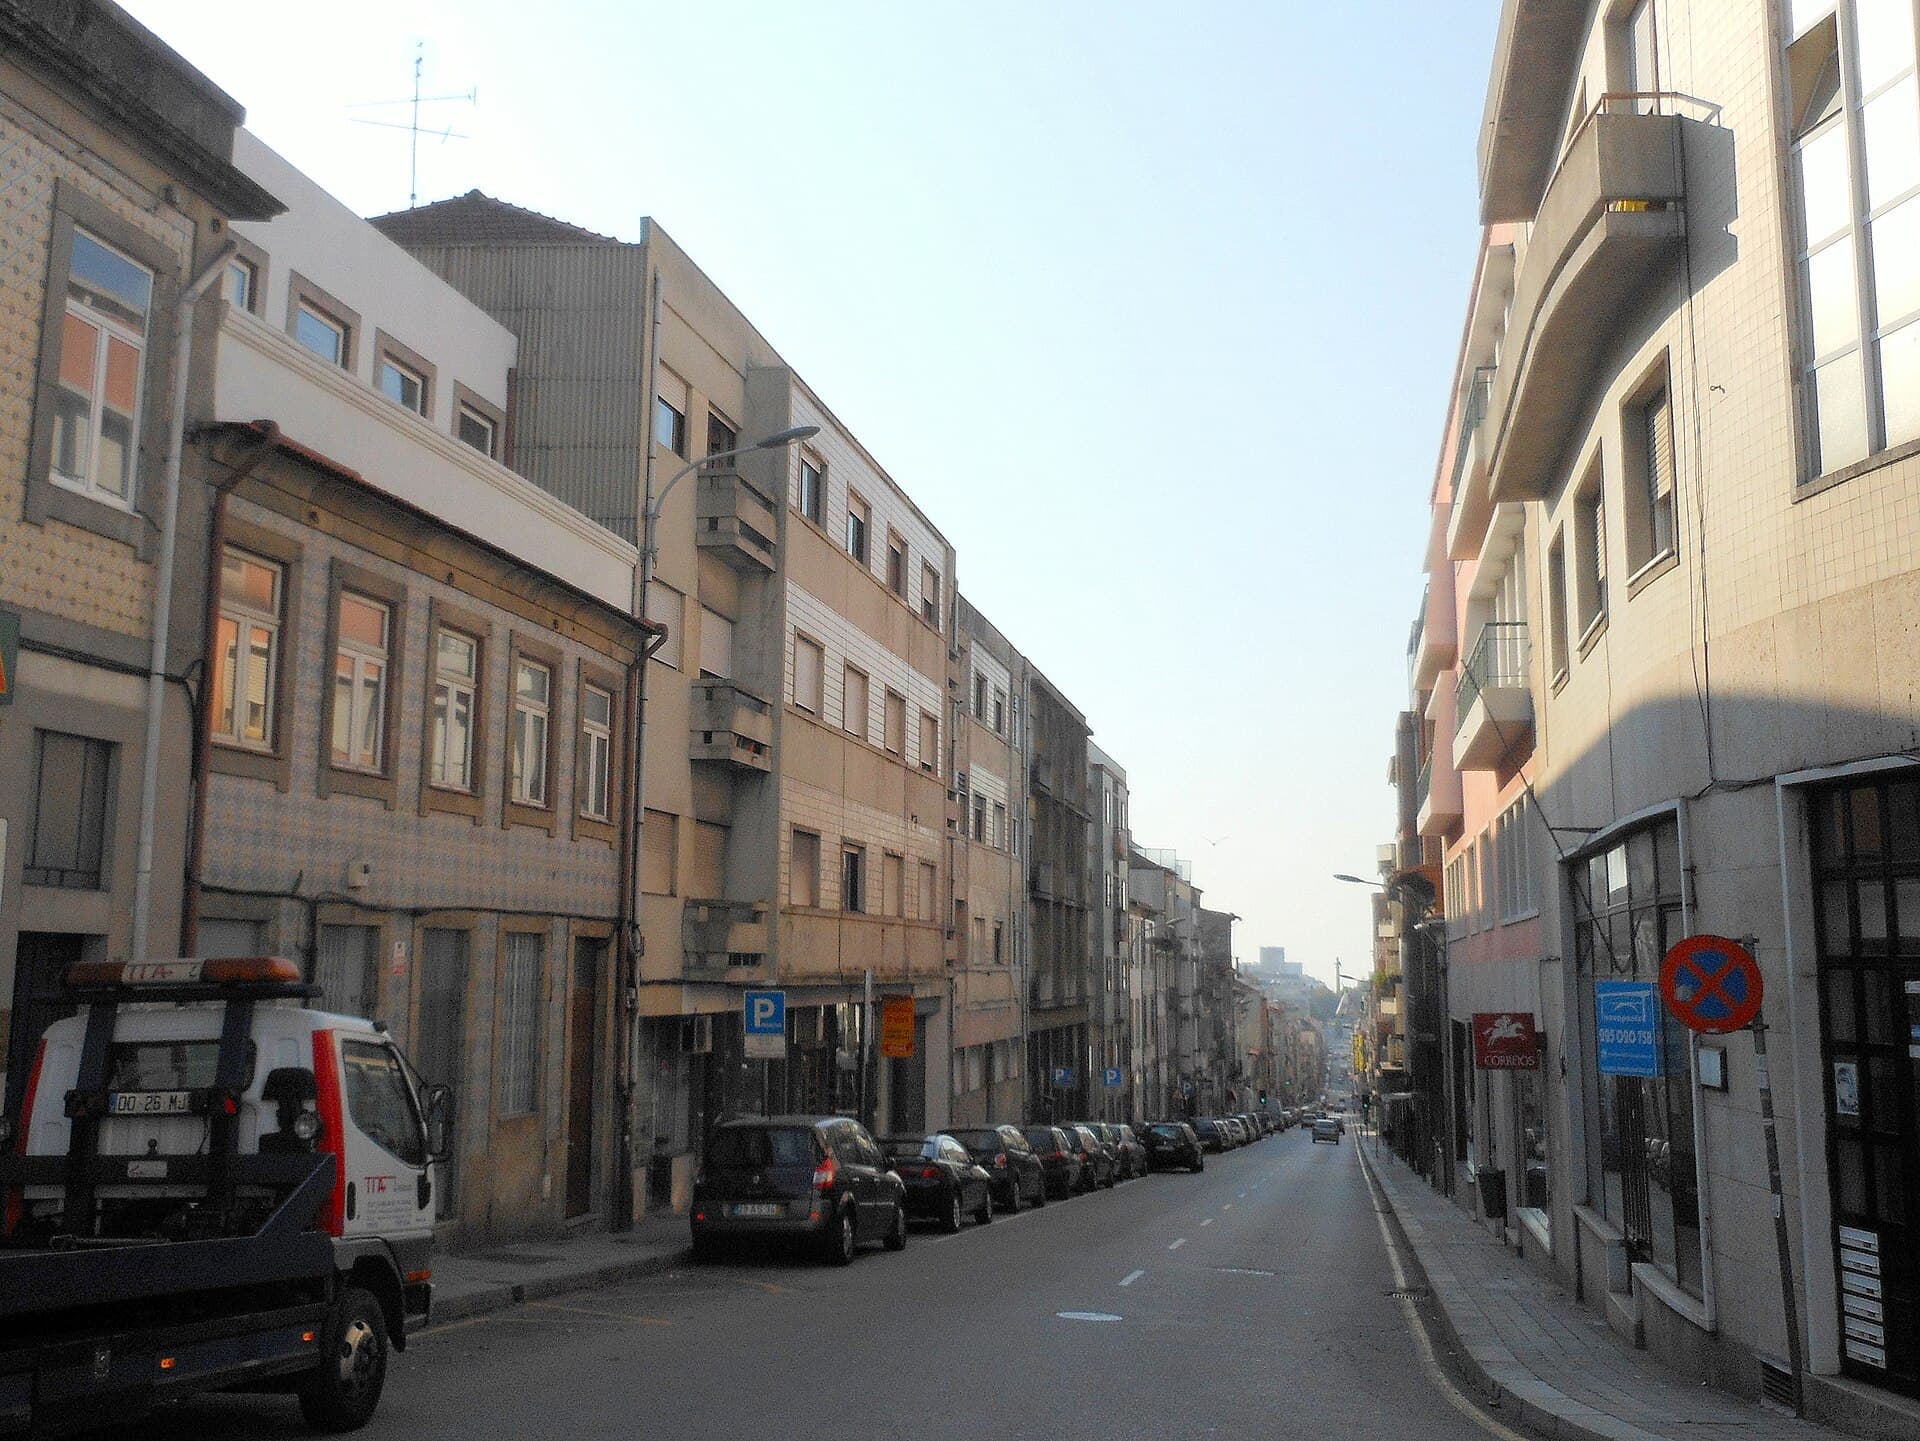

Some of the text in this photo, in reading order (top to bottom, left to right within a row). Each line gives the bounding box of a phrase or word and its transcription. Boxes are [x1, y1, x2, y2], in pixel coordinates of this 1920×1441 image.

[754, 998, 775, 1027] P
[1484, 1055, 1535, 1066] CORREIOS
[1055, 1068, 1065, 1081] P
[1106, 1070, 1116, 1085] P
